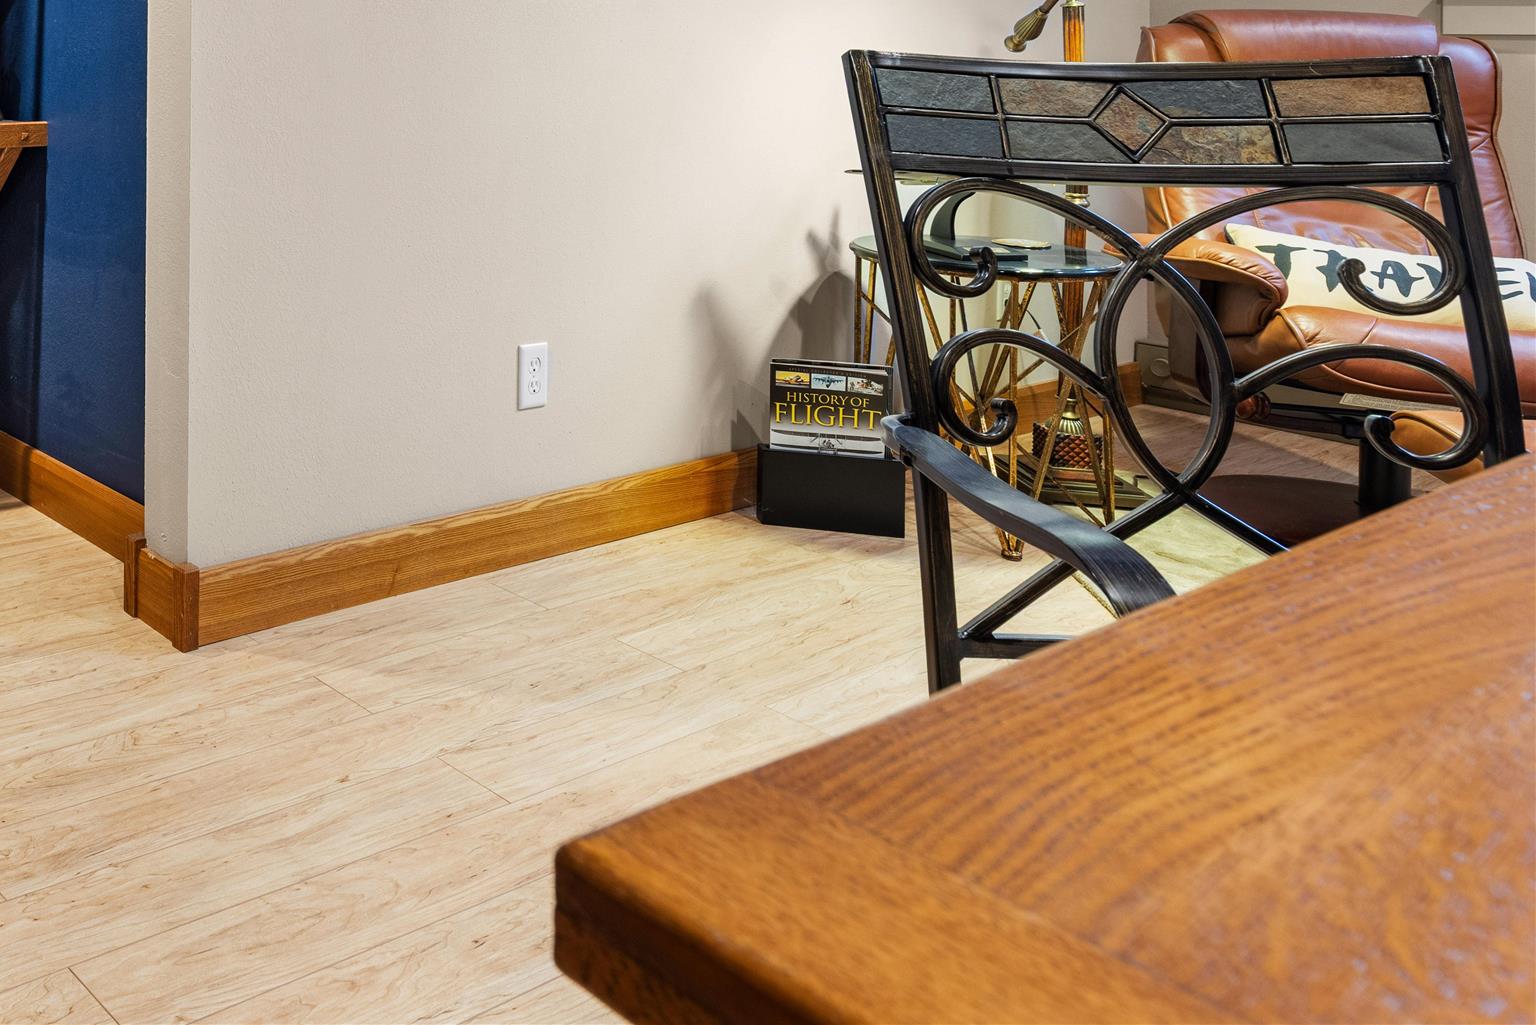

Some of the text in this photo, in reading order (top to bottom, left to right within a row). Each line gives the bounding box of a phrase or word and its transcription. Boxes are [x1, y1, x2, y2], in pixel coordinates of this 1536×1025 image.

[787, 391, 869, 407] HISTORY OF
[774, 402, 881, 430] FLIGHT
